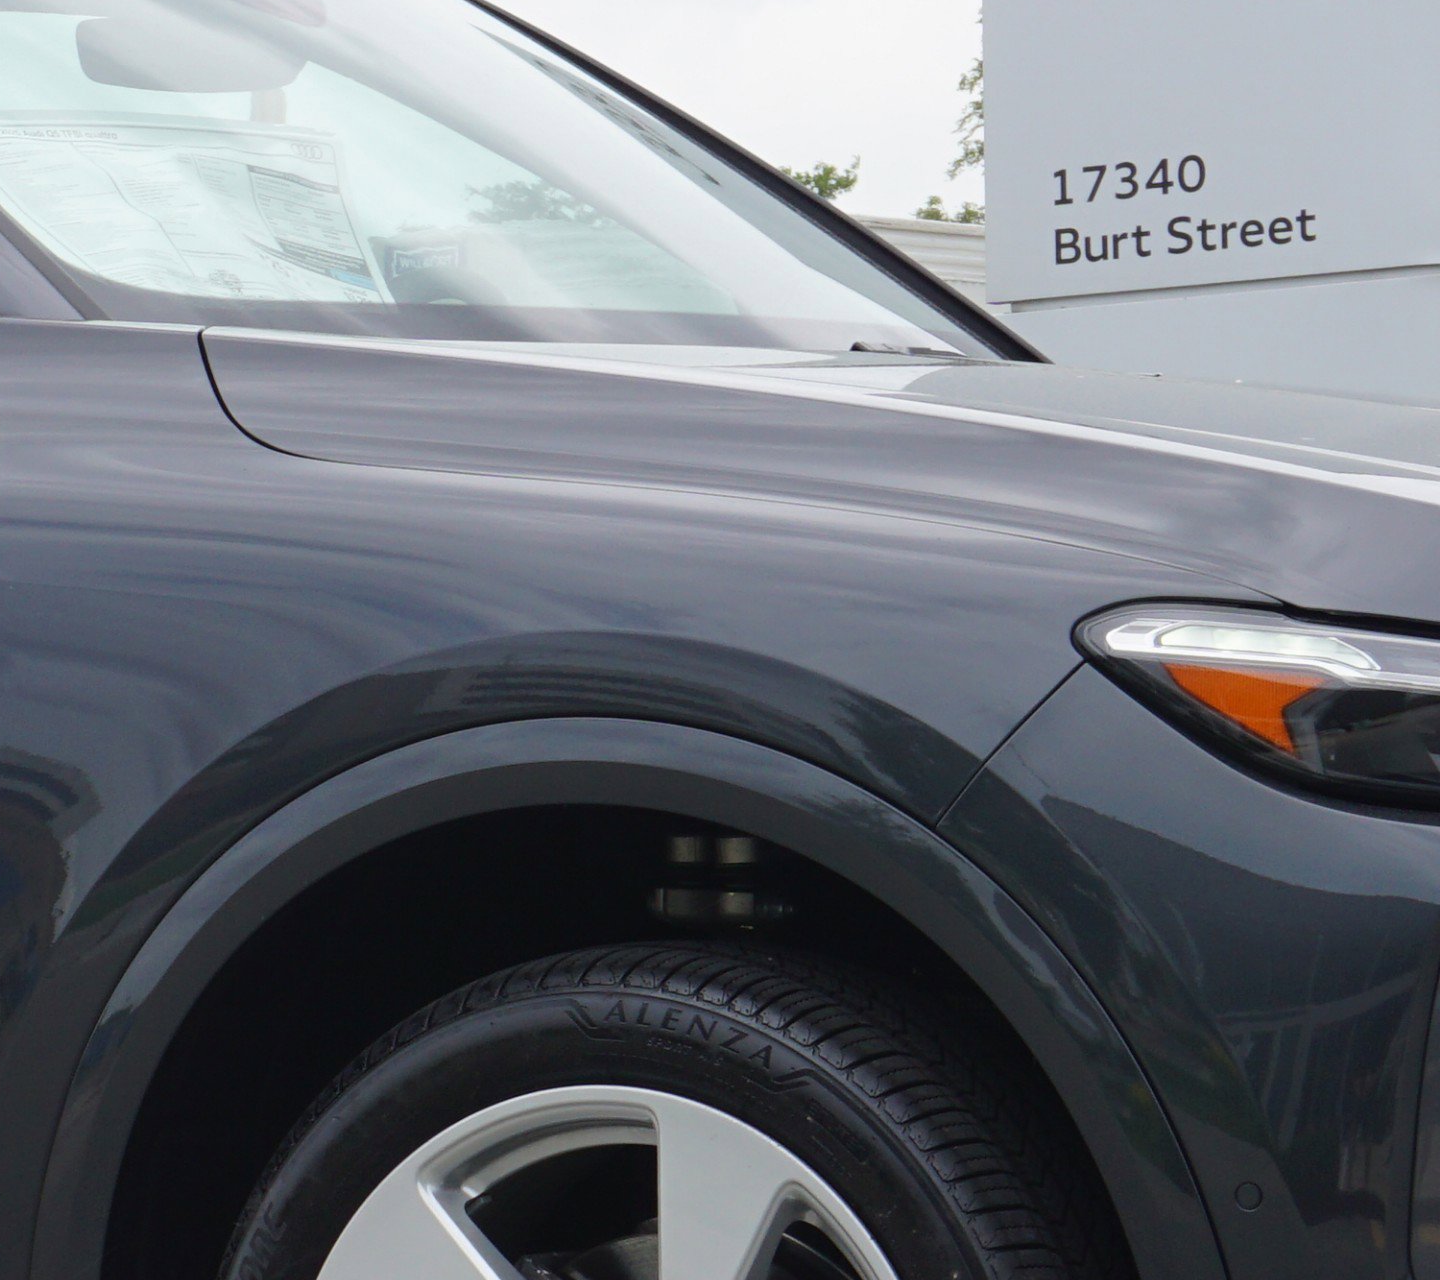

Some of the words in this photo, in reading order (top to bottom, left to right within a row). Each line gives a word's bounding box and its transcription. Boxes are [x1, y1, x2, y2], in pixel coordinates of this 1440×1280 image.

[1052, 154, 1207, 206] 17340
[1054, 224, 1152, 266] Burt
[1167, 208, 1318, 255] Street
[604, 999, 773, 1070] ALENZA
